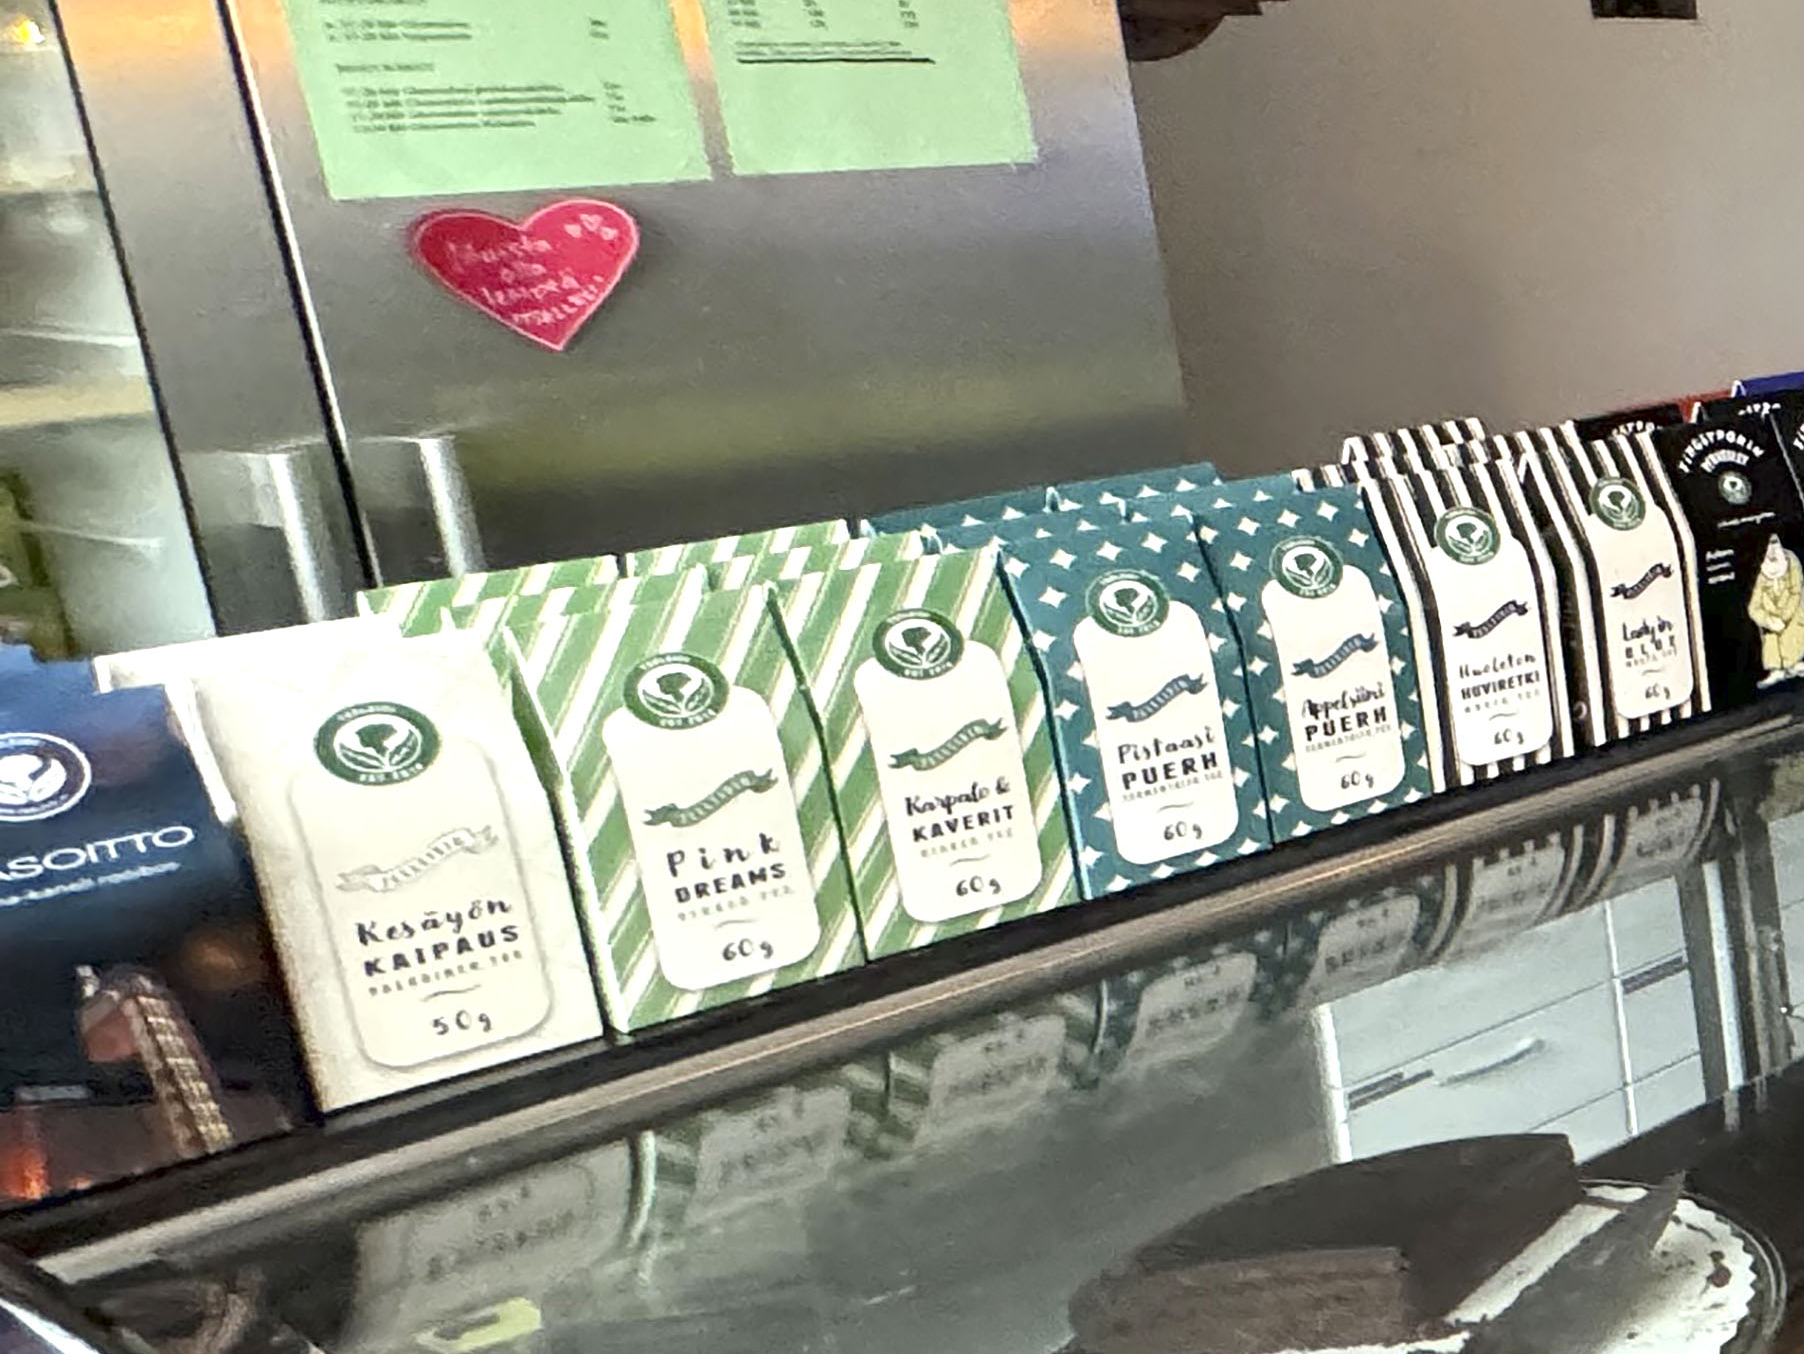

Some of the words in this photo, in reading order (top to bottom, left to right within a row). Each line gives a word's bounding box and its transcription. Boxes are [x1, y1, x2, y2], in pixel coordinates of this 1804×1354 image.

[1459, 653, 1537, 680] Huoleton
[1625, 635, 1676, 659] BLUE
[1461, 670, 1541, 700] HUVIRETKI
[1304, 705, 1387, 742] PUERH
[1117, 726, 1216, 764] Pistaasi
[1121, 752, 1218, 790] PUERH
[905, 781, 991, 817] Karpalo
[995, 775, 1012, 796] &
[912, 804, 1014, 843] KAVERIT
[0, 825, 195, 881] SOITTO
[666, 832, 781, 878] Pink
[675, 862, 786, 903] DREAMS
[356, 899, 512, 947] Kesäyön
[364, 925, 519, 976] KAIPAUS
